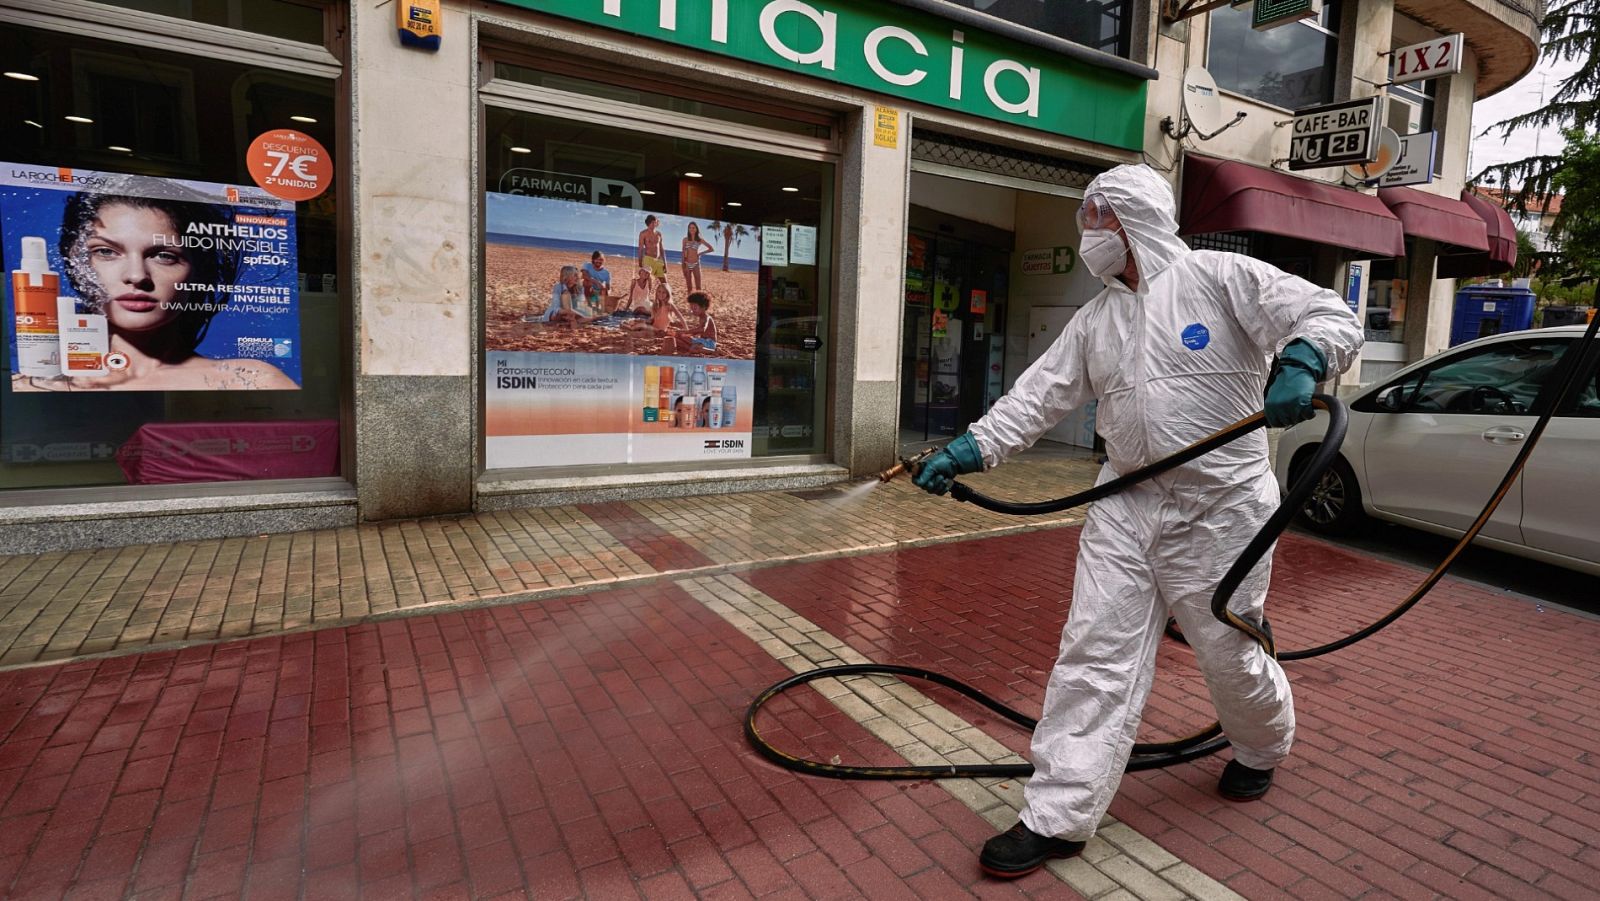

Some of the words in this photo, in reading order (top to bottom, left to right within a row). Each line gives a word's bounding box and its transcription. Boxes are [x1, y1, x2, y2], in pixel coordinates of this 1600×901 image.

[1294, 109, 1369, 133] CAFE-BAR
[262, 142, 319, 156] DESCUENTO
[1291, 137, 1324, 163] MJ
[1332, 134, 1360, 154] 28
[263, 150, 318, 181] -7€
[11, 169, 28, 179] LA
[277, 178, 317, 189] UNIDAD
[511, 175, 587, 196] FARMACIA
[186, 222, 288, 240] ANTHELIOS
[152, 233, 214, 249] FLUIDO
[216, 238, 289, 255] INVISIBLE
[243, 255, 289, 266] spf50+
[1022, 261, 1052, 272] Guerras
[174, 282, 215, 292] ULTRA
[217, 284, 290, 295] RESISTENTE
[233, 294, 291, 305] INVISIBLE
[497, 376, 536, 389] ISDIN
[721, 440, 744, 448] ISDIN
